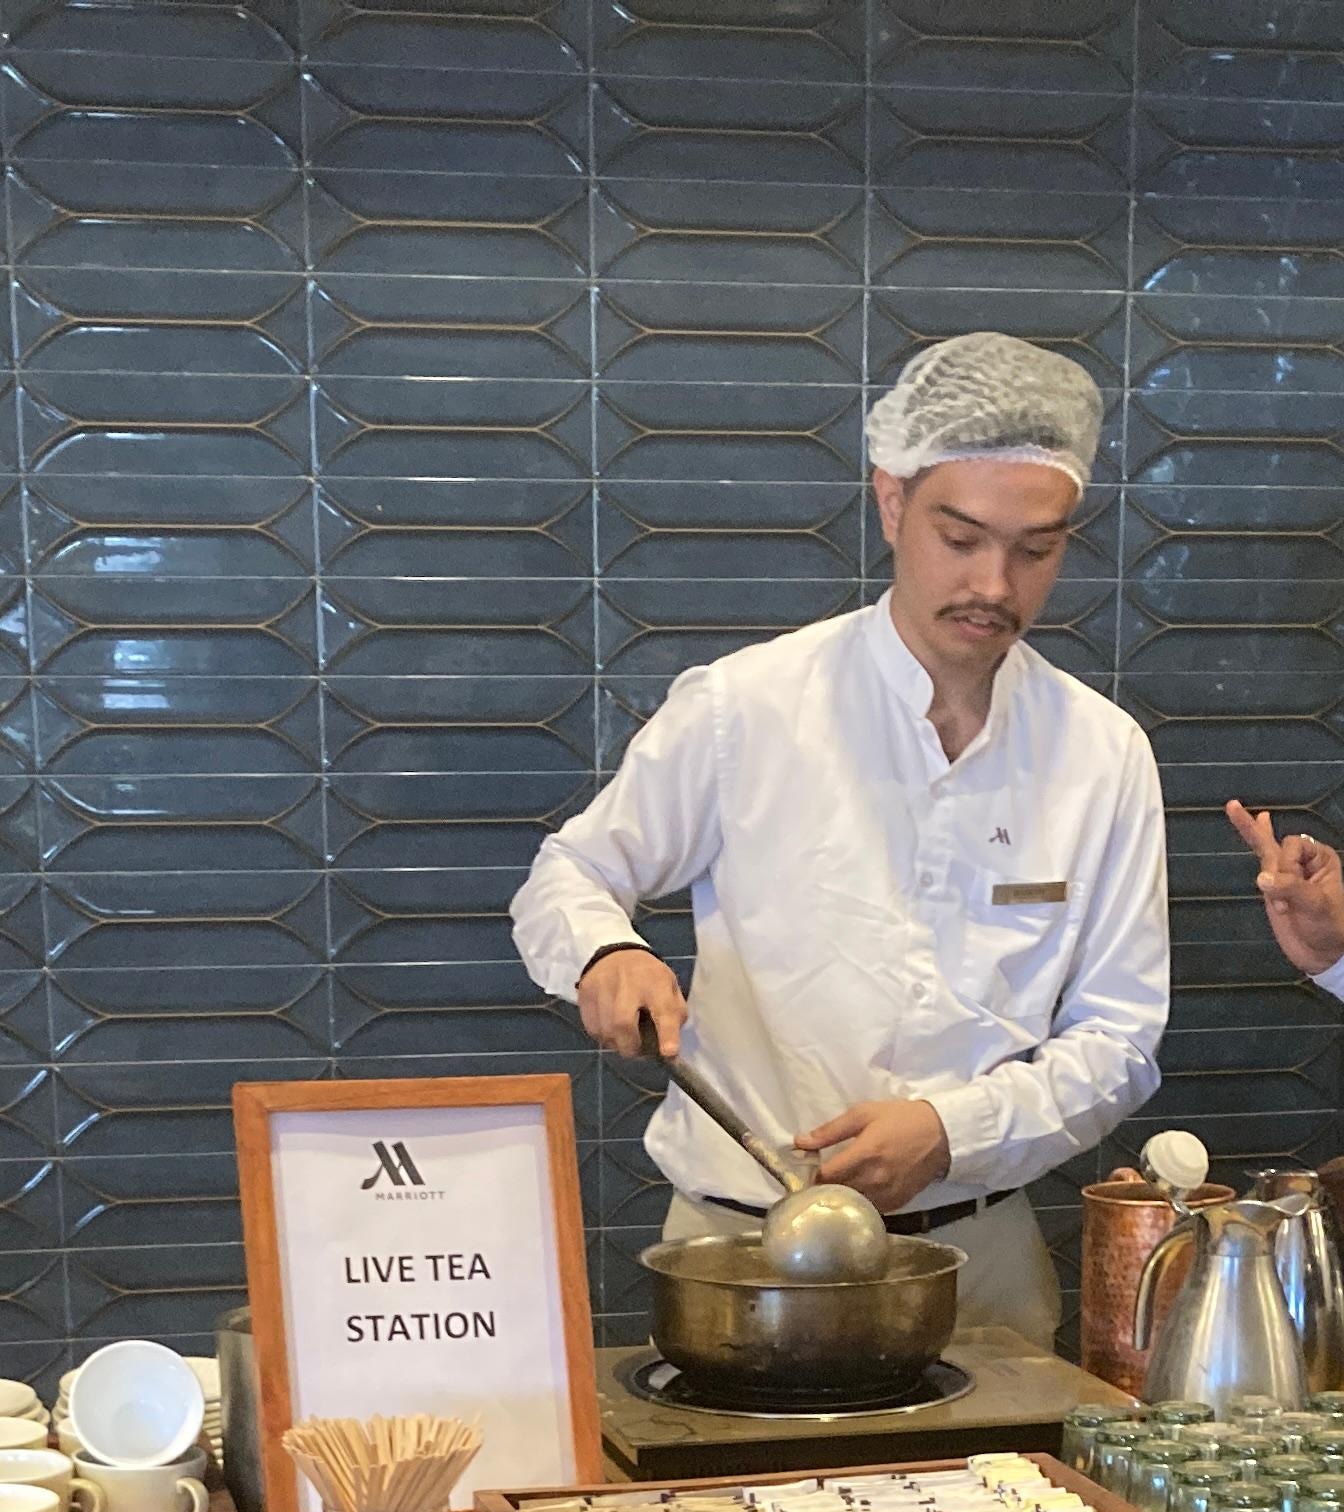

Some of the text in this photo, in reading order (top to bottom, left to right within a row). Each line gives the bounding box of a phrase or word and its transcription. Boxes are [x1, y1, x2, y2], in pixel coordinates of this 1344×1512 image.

[375, 1191, 446, 1201] MARRIOTT
[344, 1252, 492, 1285] LIVE TEA
[346, 1310, 497, 1343] STATION
